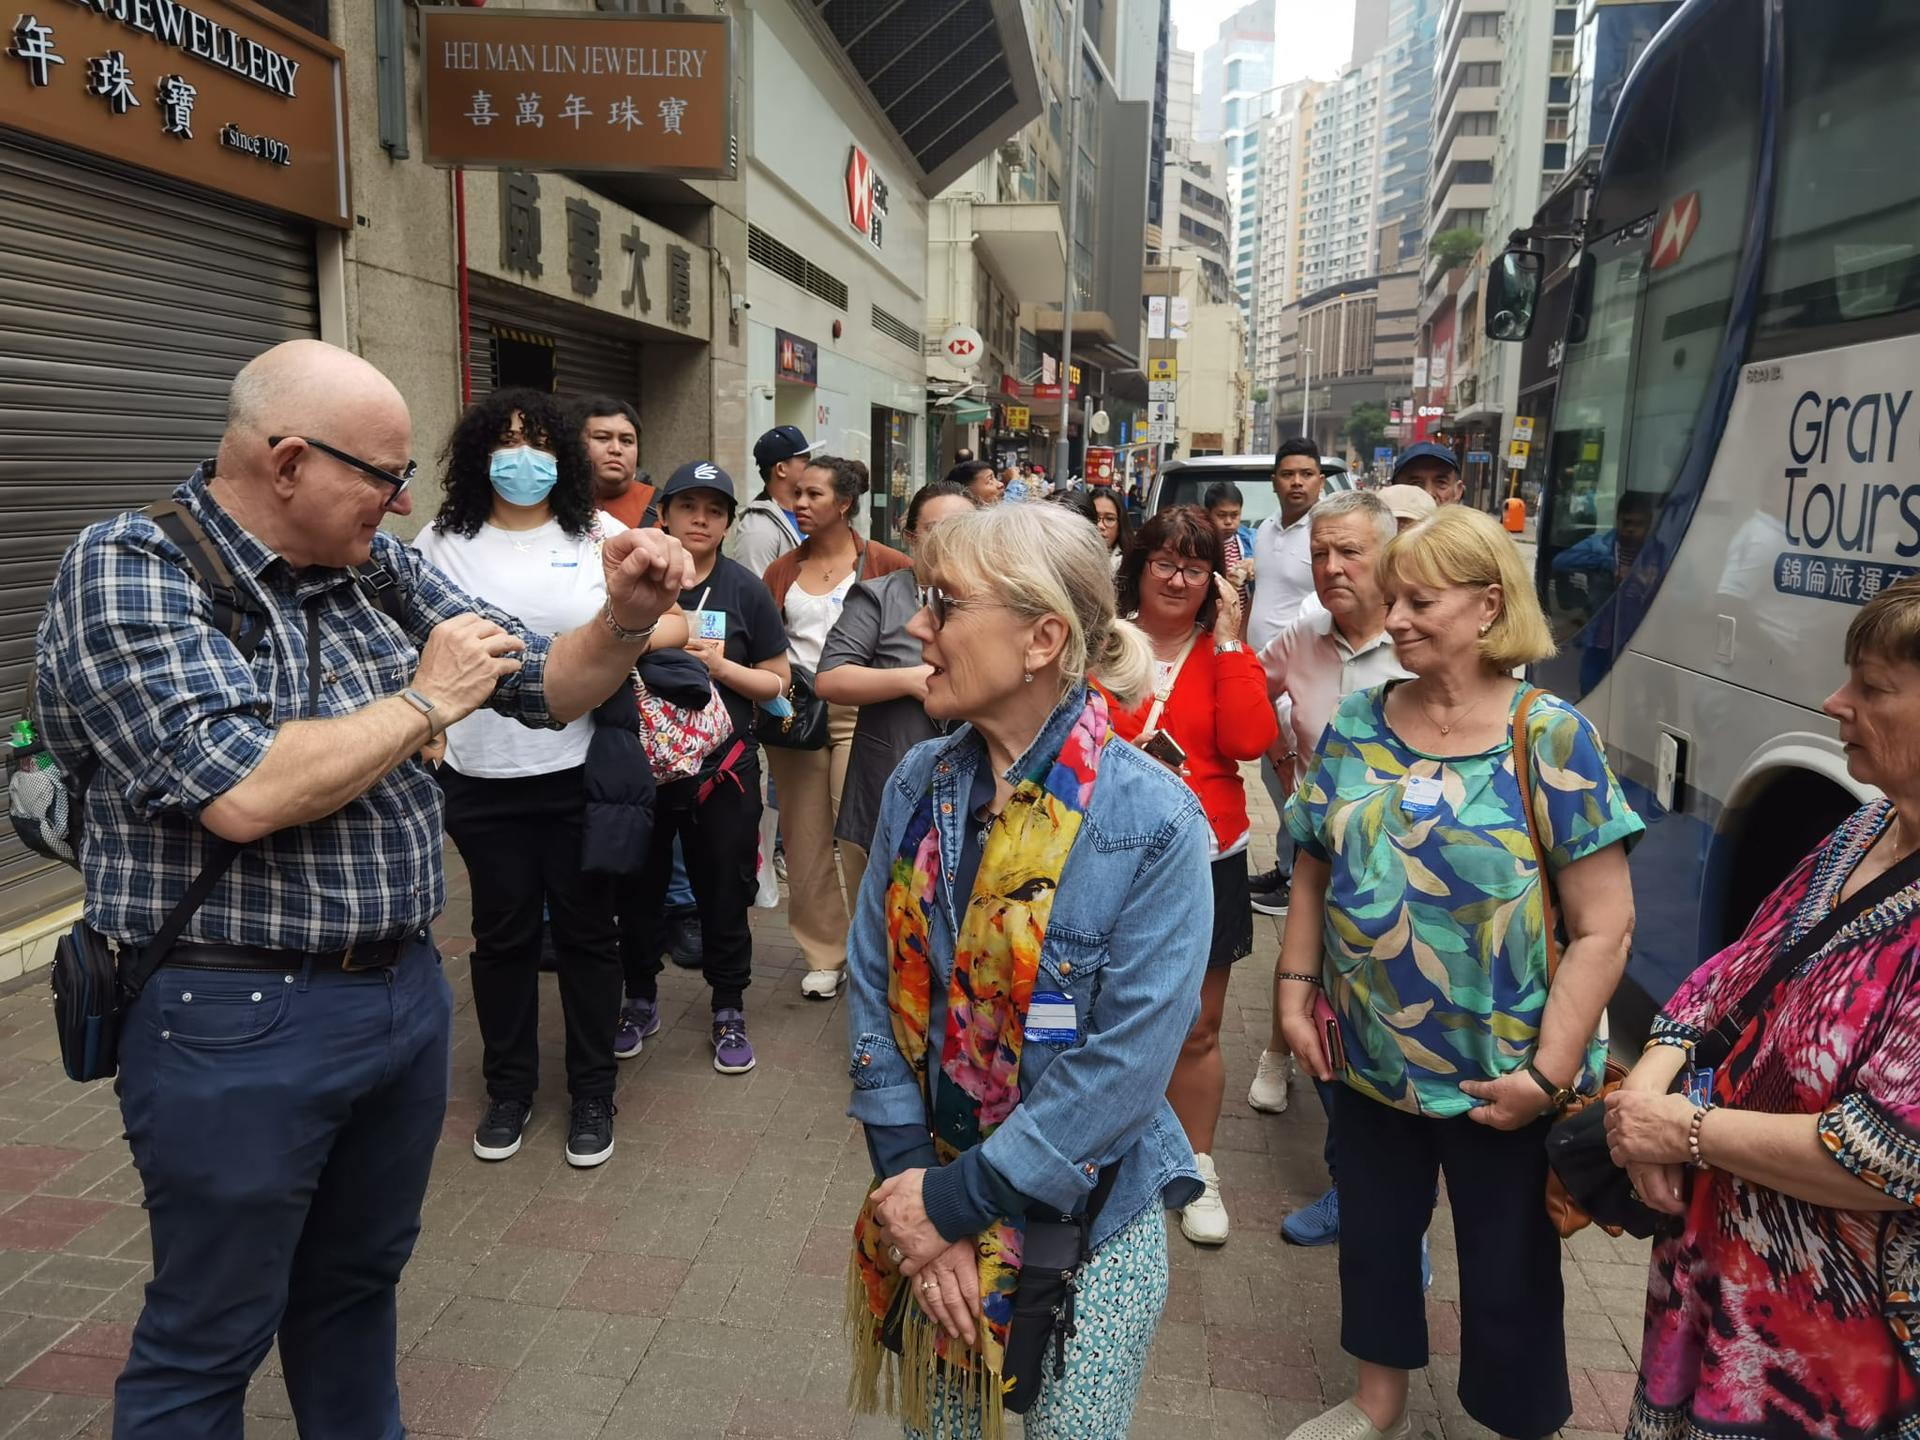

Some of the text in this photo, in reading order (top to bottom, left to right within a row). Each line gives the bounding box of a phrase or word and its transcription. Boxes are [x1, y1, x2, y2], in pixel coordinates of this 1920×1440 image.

[444, 41, 708, 78] HEI MAN LIN JEWELLERY
[463, 89, 689, 135] 喜萬年珠寶
[263, 137, 291, 165] 1972
[1789, 390, 1913, 464] Gray
[1785, 467, 1920, 558] Tours
